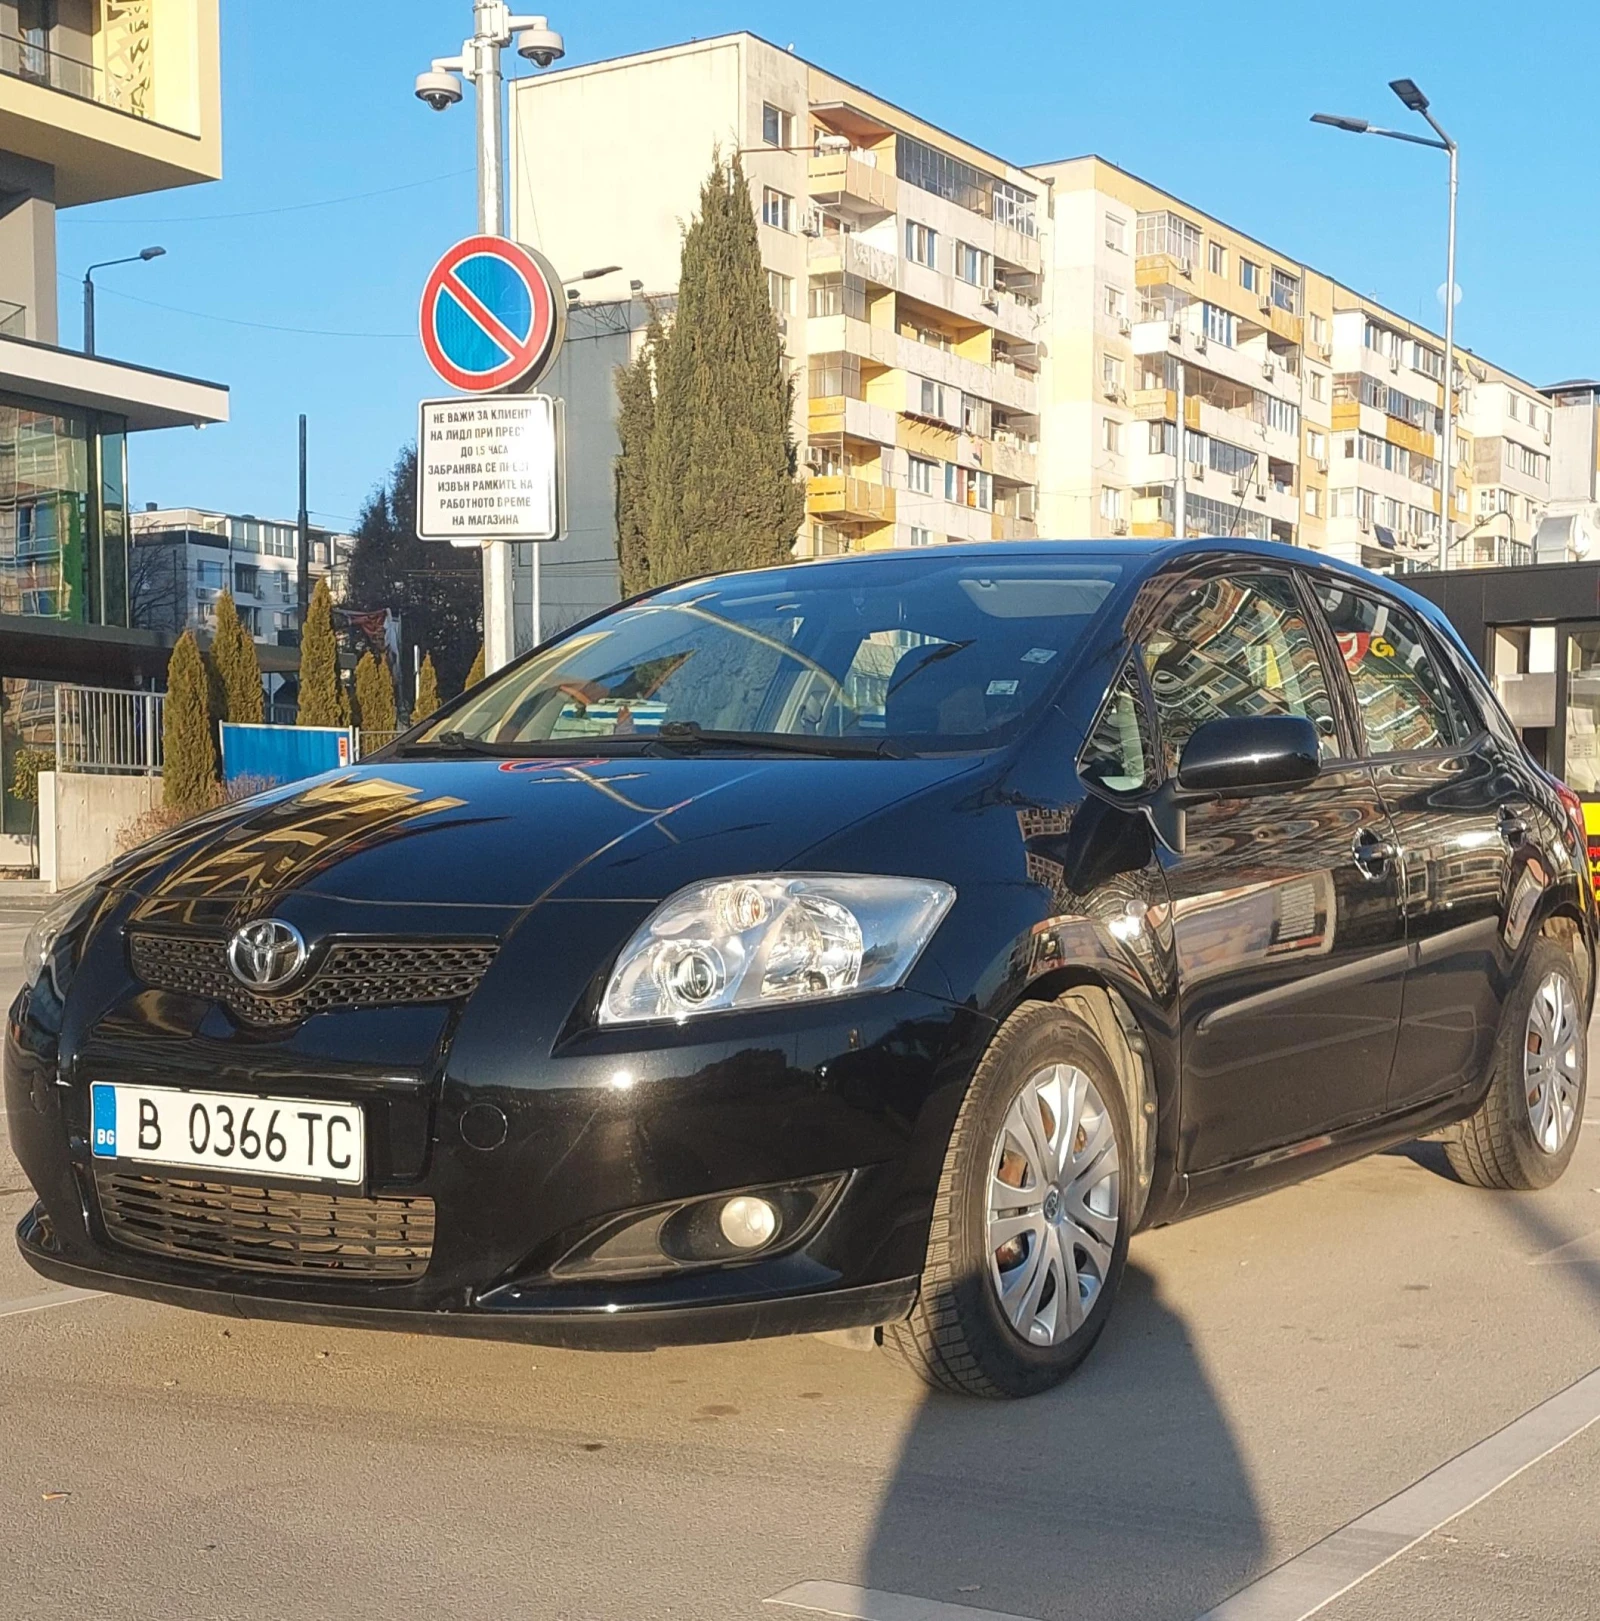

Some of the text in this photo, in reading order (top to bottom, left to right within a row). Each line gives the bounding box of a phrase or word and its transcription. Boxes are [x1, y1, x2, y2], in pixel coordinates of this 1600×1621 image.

[433, 412, 445, 424] НЕ
[447, 410, 475, 423] ВАЖИ
[477, 409, 489, 421] ЗА
[430, 430, 443, 441] НА
[445, 429, 472, 441] ЛИДЛ
[474, 428, 493, 439] ПРИ
[460, 447, 473, 459] ДО
[488, 445, 509, 455] ЧАСА
[428, 463, 482, 475] ЗАБРАНЯВА
[485, 462, 497, 473] СЕ
[438, 479, 533, 493] ИЗВЪН РАМКИТЕ НА
[440, 496, 531, 509] РАБОТНОТО ВРЕМЕ
[452, 514, 519, 526] НА МАГАЗИНА
[97, 1129, 115, 1146] BG
[138, 1098, 161, 1151] B
[189, 1102, 287, 1163] 0366
